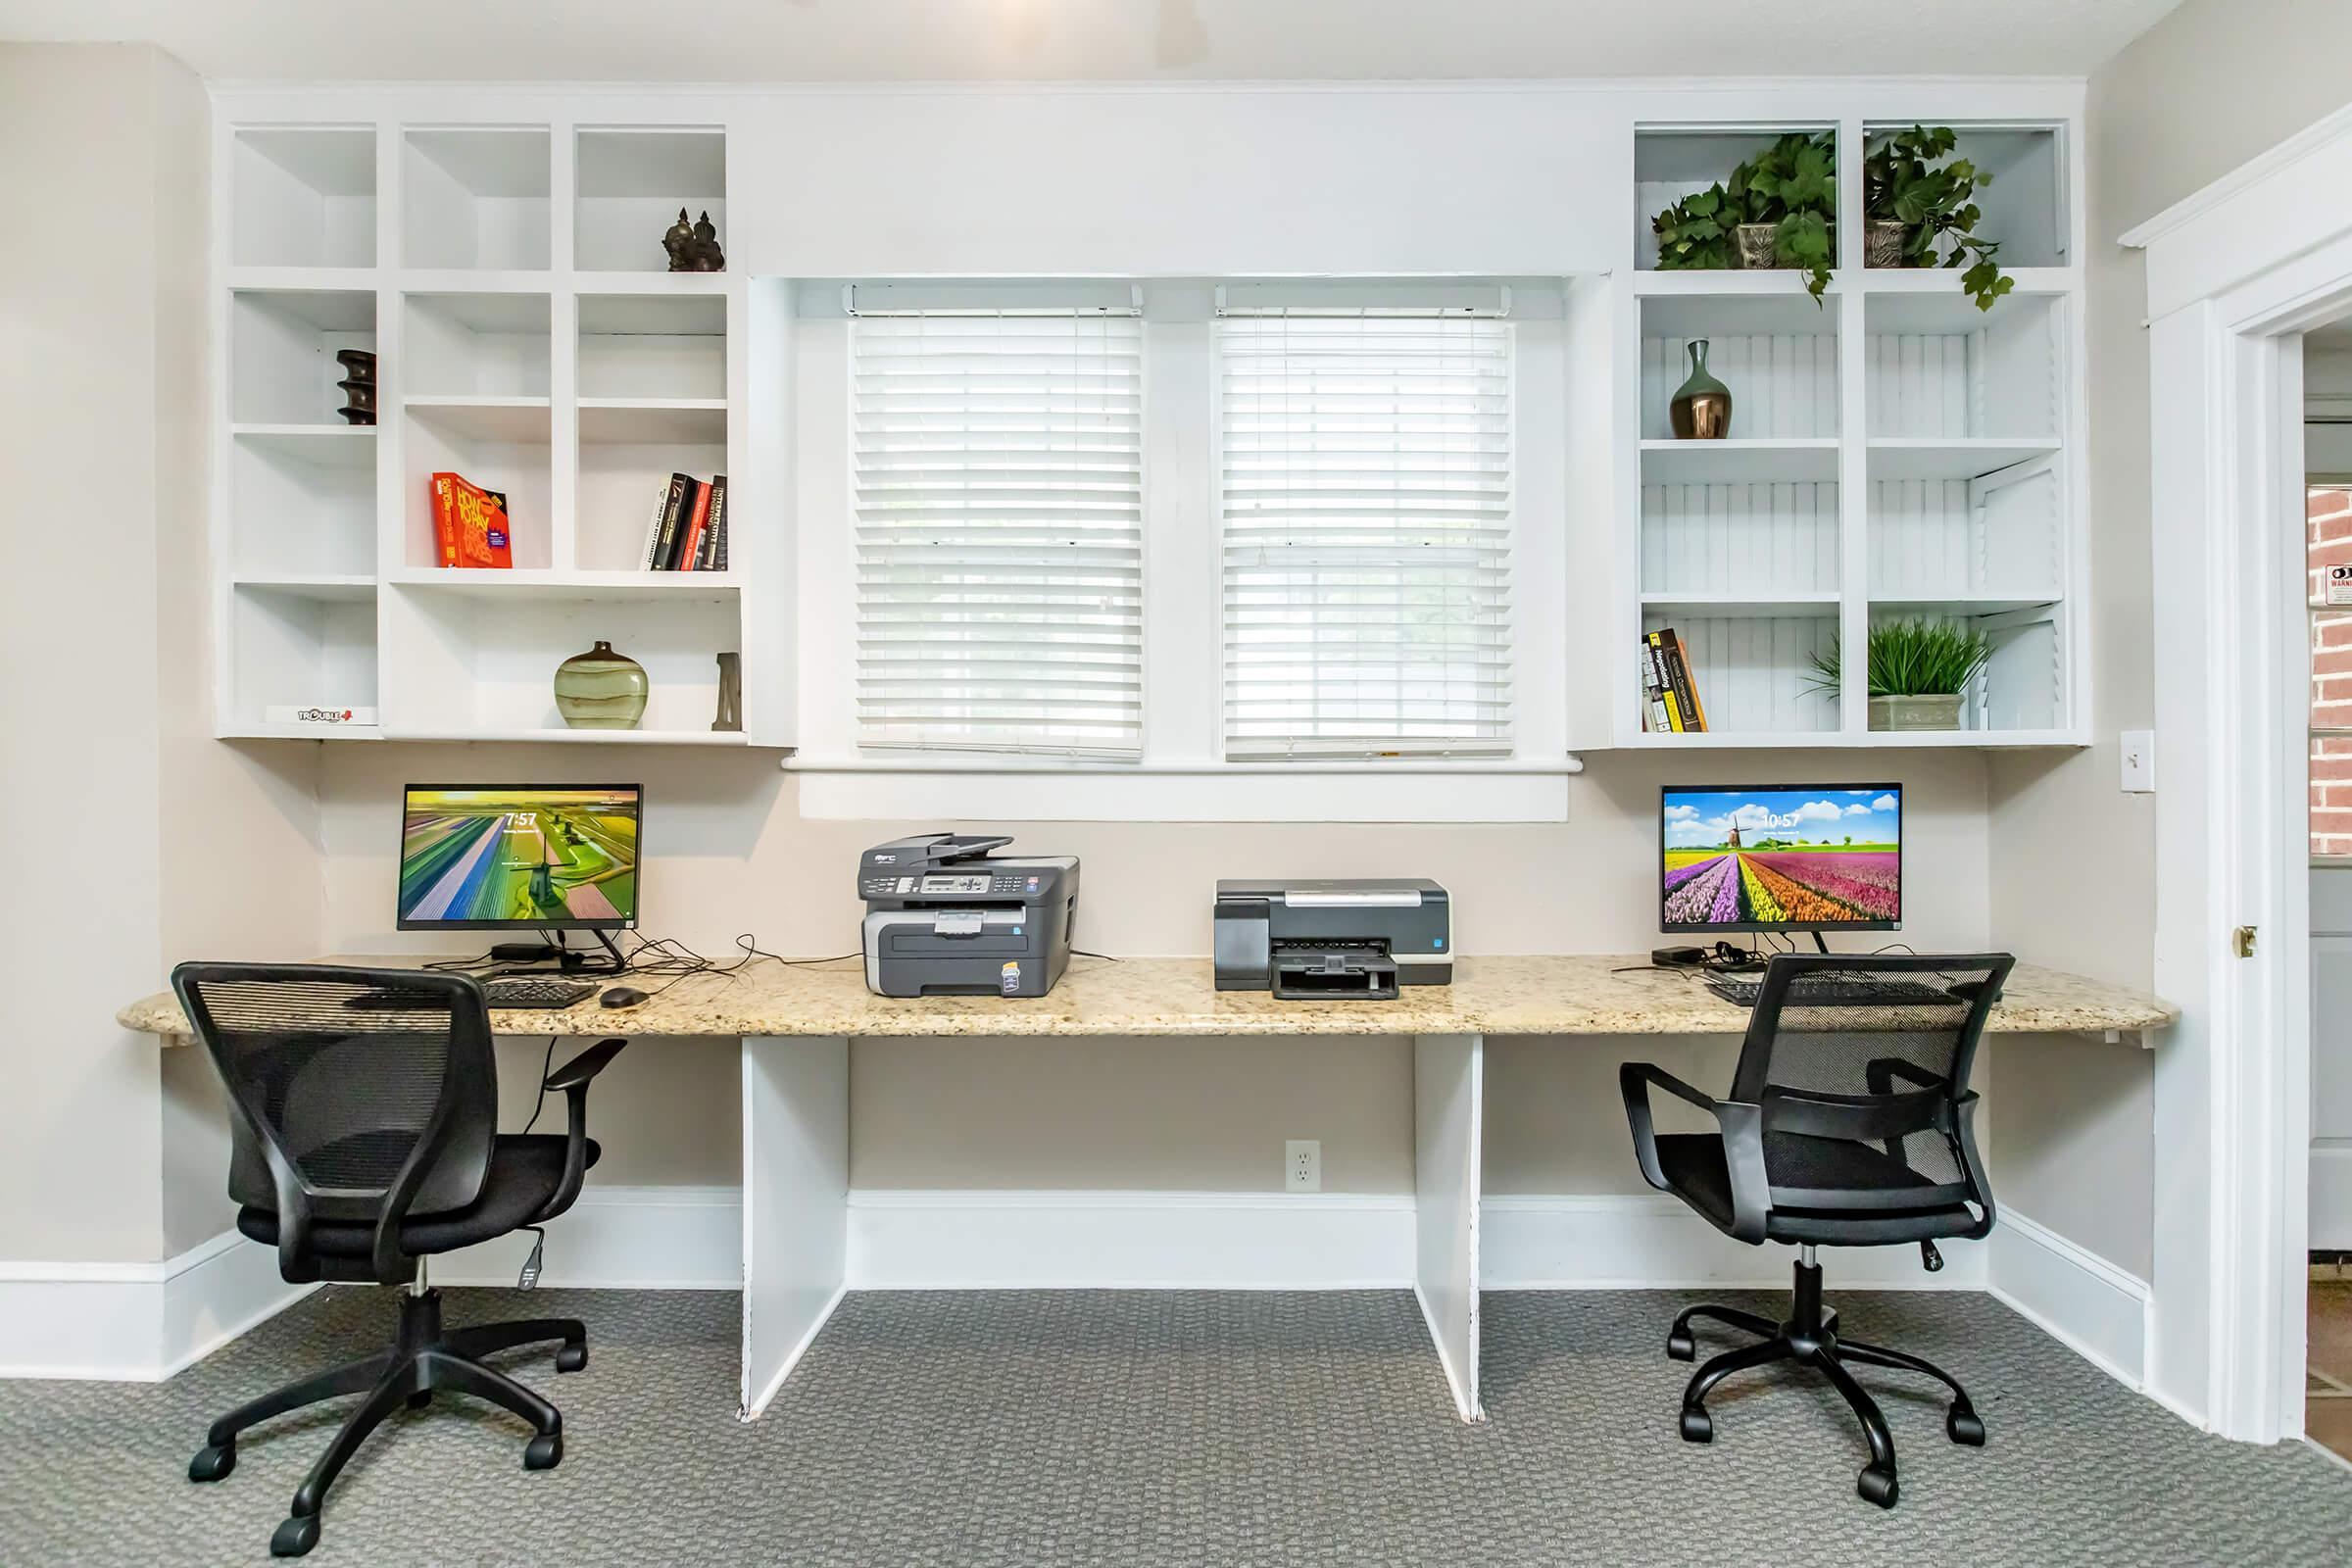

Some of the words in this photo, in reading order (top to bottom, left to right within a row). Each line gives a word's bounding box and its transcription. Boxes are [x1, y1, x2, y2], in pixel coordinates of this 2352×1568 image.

[457, 485, 481, 511] HOW
[458, 503, 471, 523] TO
[470, 508, 490, 532] PAY
[710, 486, 724, 542] INTERPRETATIVE
[1655, 649, 1670, 689] Negotiating
[298, 709, 341, 721] TROUBLE
[506, 812, 537, 825] 7:57
[1763, 813, 1800, 827] 10:57
